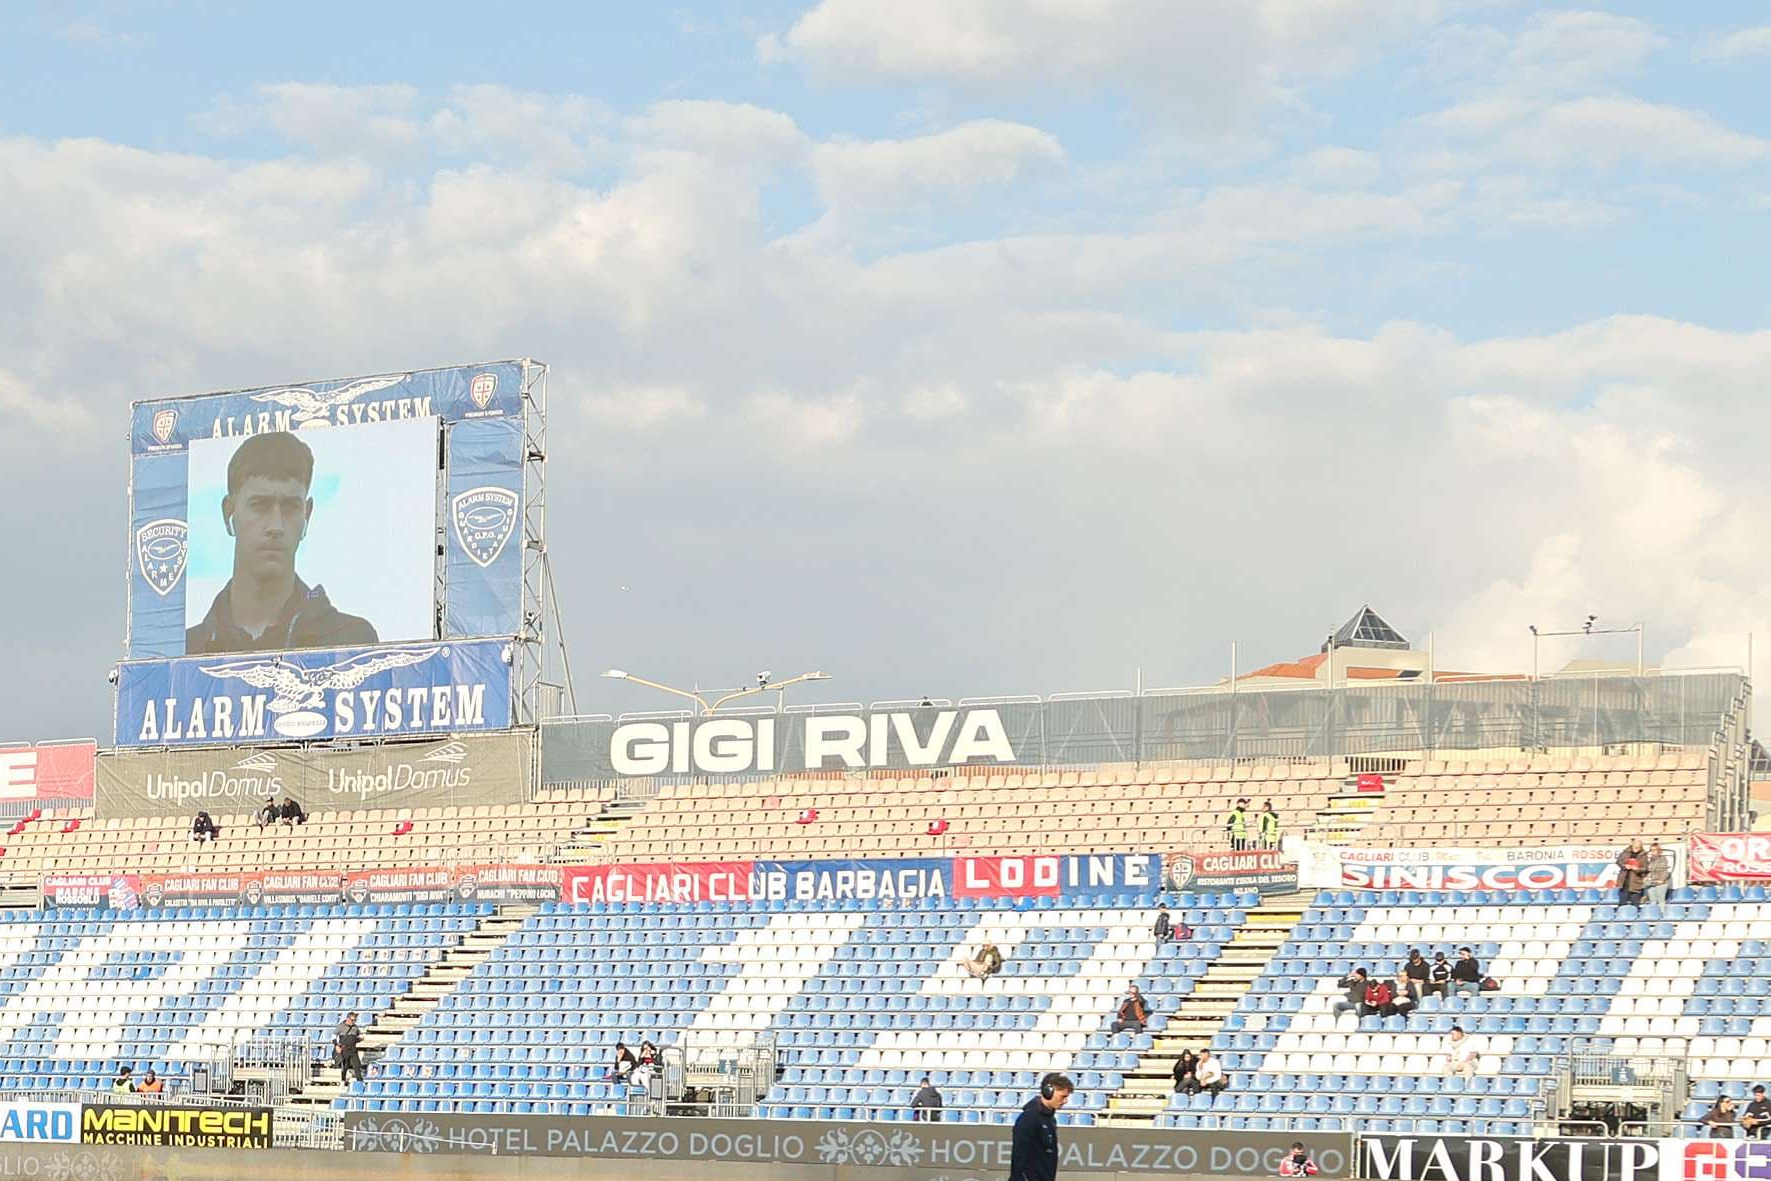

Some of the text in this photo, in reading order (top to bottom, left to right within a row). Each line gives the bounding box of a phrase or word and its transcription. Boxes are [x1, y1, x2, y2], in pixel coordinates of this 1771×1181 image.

[213, 397, 432, 439] ALARM SYSTEM
[458, 493, 485, 510] ALARM
[141, 527, 187, 540] SECURITY
[139, 683, 486, 741] ALARM SYSTEM
[610, 709, 1016, 775] GIGI RIVA
[147, 771, 282, 806] UnipolDomus
[329, 764, 472, 800] UnipolDomus
[1203, 855, 1257, 872] CAGLIARI
[1340, 851, 1394, 862] CAGLIARI
[1507, 849, 1564, 861] BARONIA
[1572, 849, 1620, 861] ROSSOB
[45, 876, 111, 887] CAGLIARI CLUB
[164, 878, 239, 891] CAGLIARI FAN CLUB
[370, 873, 448, 889] CAGLIARI FAN CLUB
[572, 868, 945, 903] CAGLIARI CLUB BARBAGIA
[966, 855, 1150, 889] LODINE
[1342, 863, 1620, 889] SINISCOLA
[84, 1132, 268, 1149] MACCHINE INDUSTRIALI
[450, 1127, 804, 1159] HOTEL PALAZZO DOGLIO
[931, 1140, 1344, 1174] HOTE ALAZZO DOGIO
